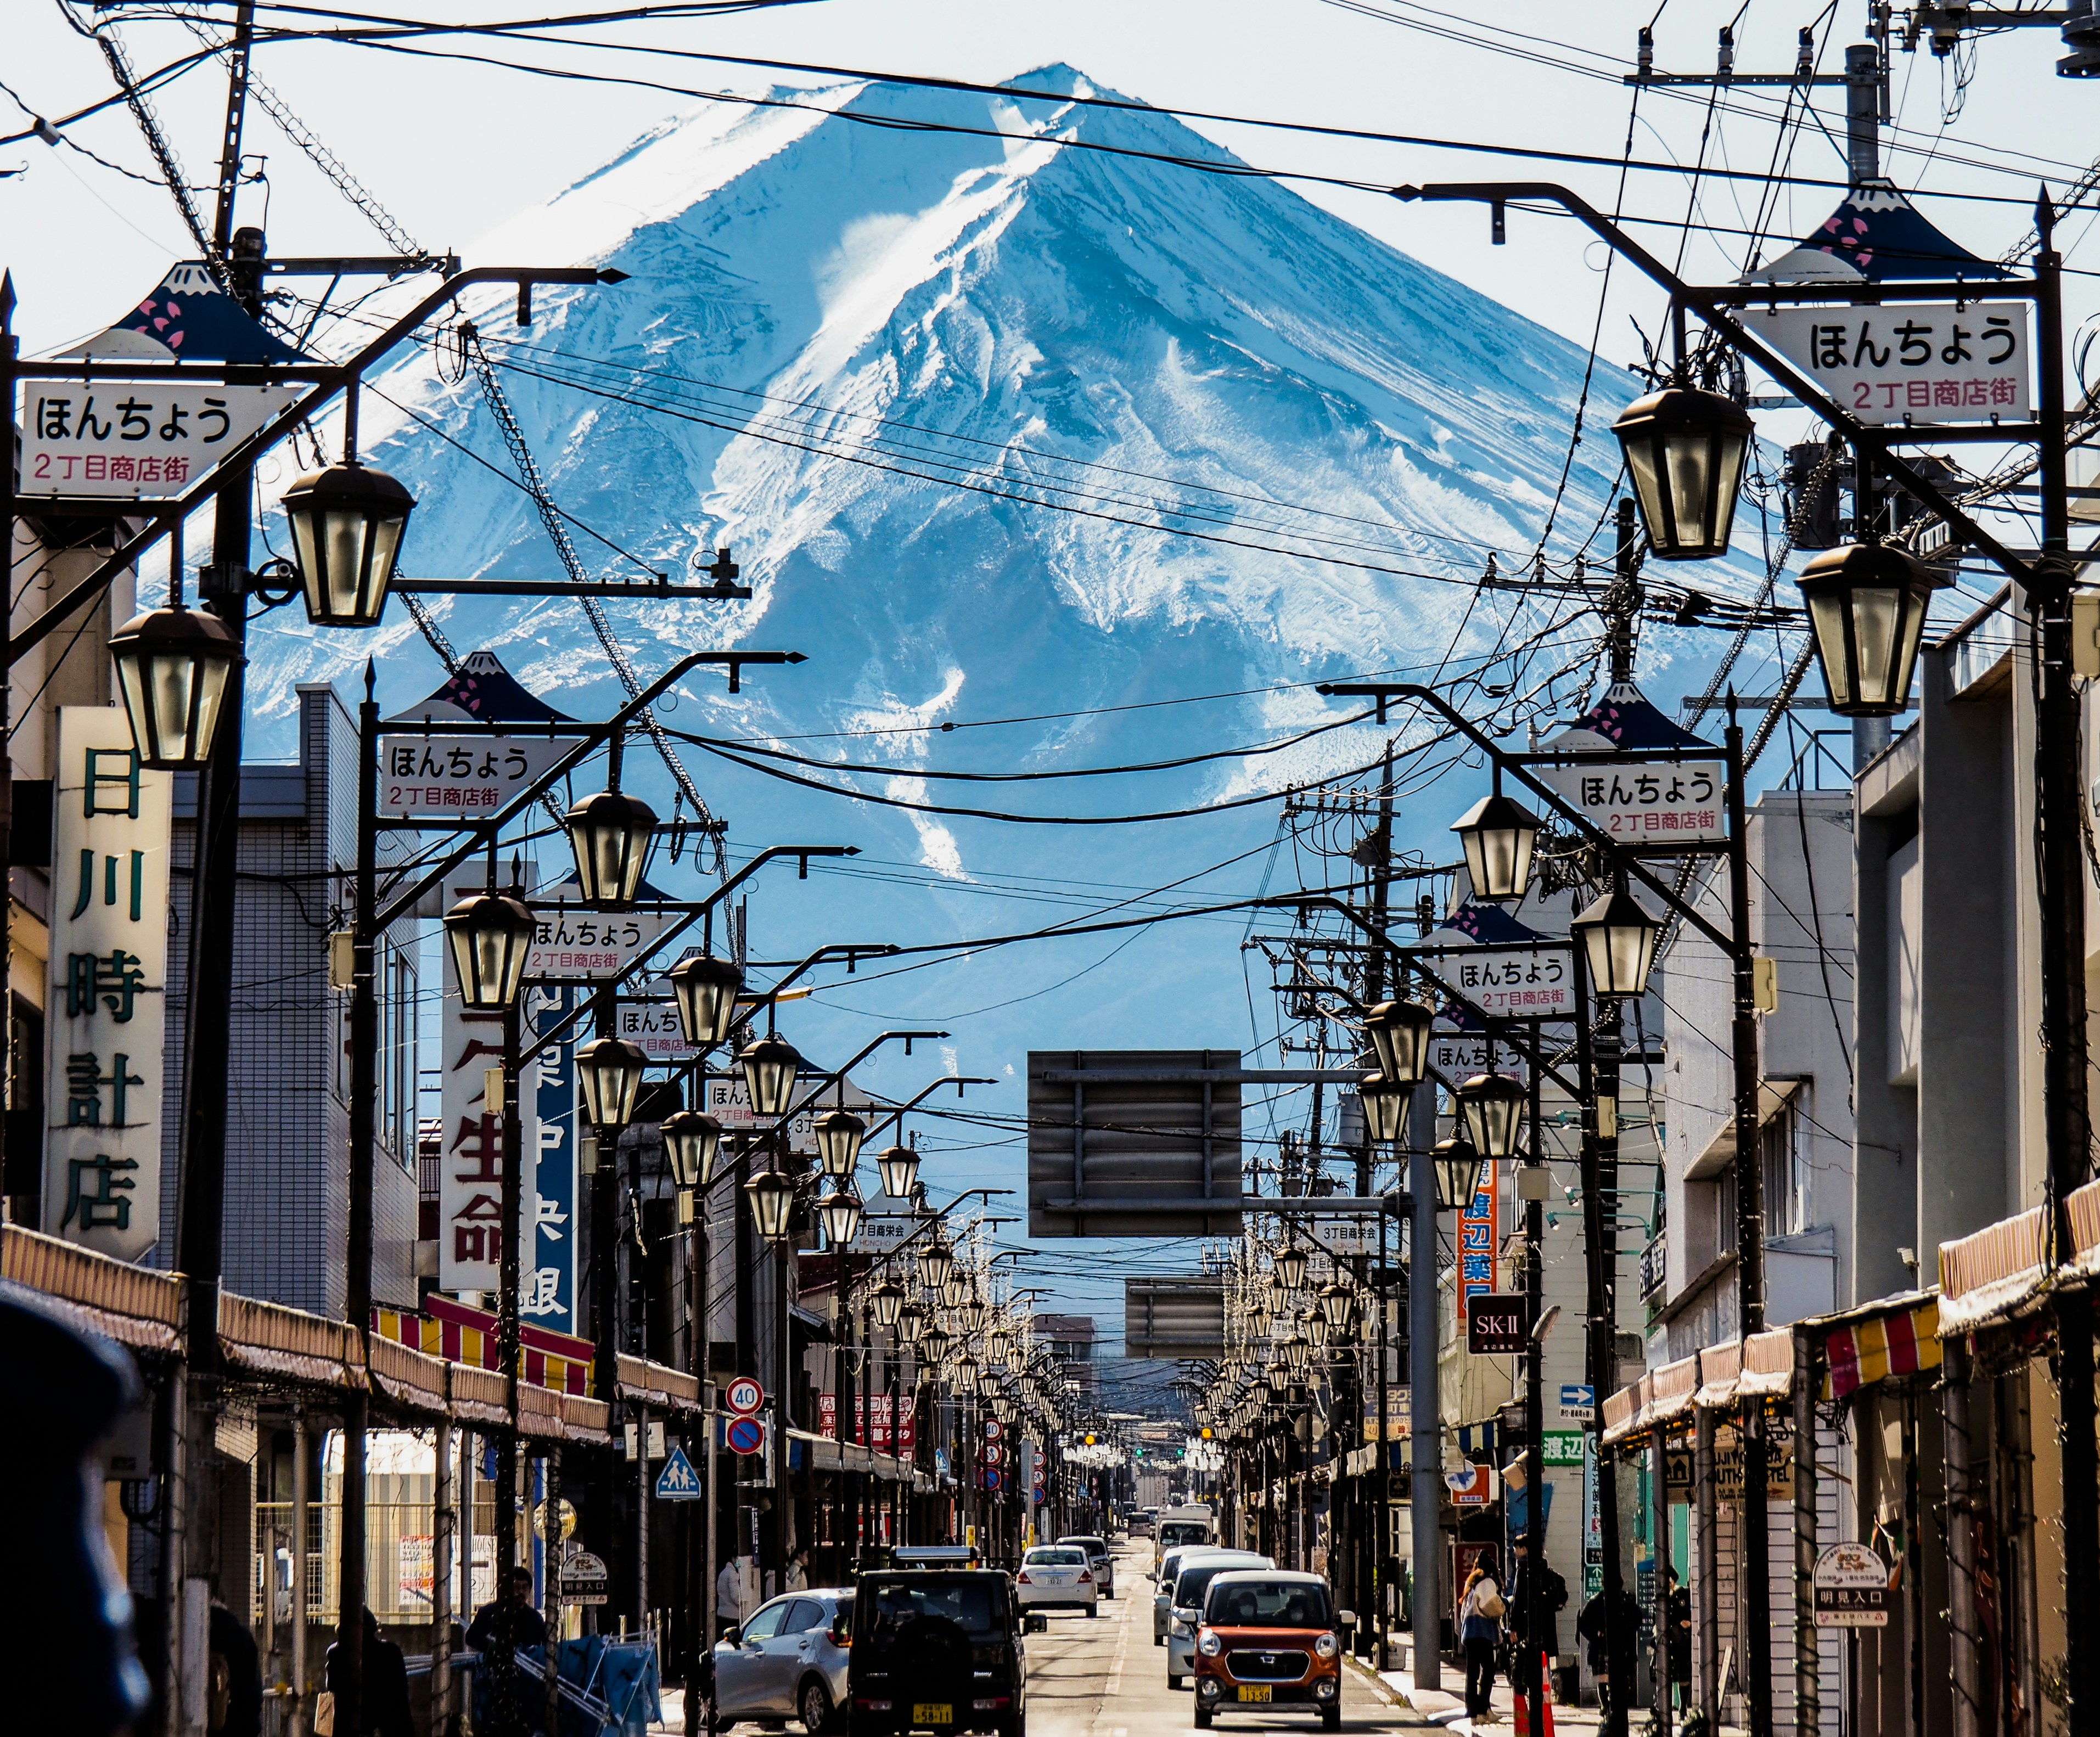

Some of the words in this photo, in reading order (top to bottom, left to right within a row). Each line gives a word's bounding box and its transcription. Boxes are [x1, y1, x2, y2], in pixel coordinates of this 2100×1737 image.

[1811, 317, 2016, 369] ほんちょう
[1853, 377, 2017, 409] 2丁目商店街
[36, 396, 231, 443] ほんちょう
[34, 453, 190, 484] 2丁目商店街
[391, 746, 529, 780] ほんちょう
[390, 787, 499, 807] 2丁目商店街
[1581, 772, 1714, 806] ほんちょう
[1609, 810, 1715, 832] 2丁目商店街
[532, 921, 641, 948] ほんちょう
[532, 952, 617, 968] 2丁目商店街
[1460, 958, 1563, 987] ほんちょう
[60, 747, 144, 1232] 日川時計店
[1483, 988, 1564, 1007] 2丁目商店街
[1324, 1227, 1375, 1240] 3丁目商栄会
[1476, 1316, 1518, 1334] SK-II
[735, 1388, 755, 1404] 40
[986, 1425, 998, 1435] 40
[471, 1537, 497, 1553] HOUSE
[1821, 1590, 1882, 1604] 明見入口
[1246, 1691, 1270, 1701] 13-50
[922, 1712, 949, 1722] 58-11
